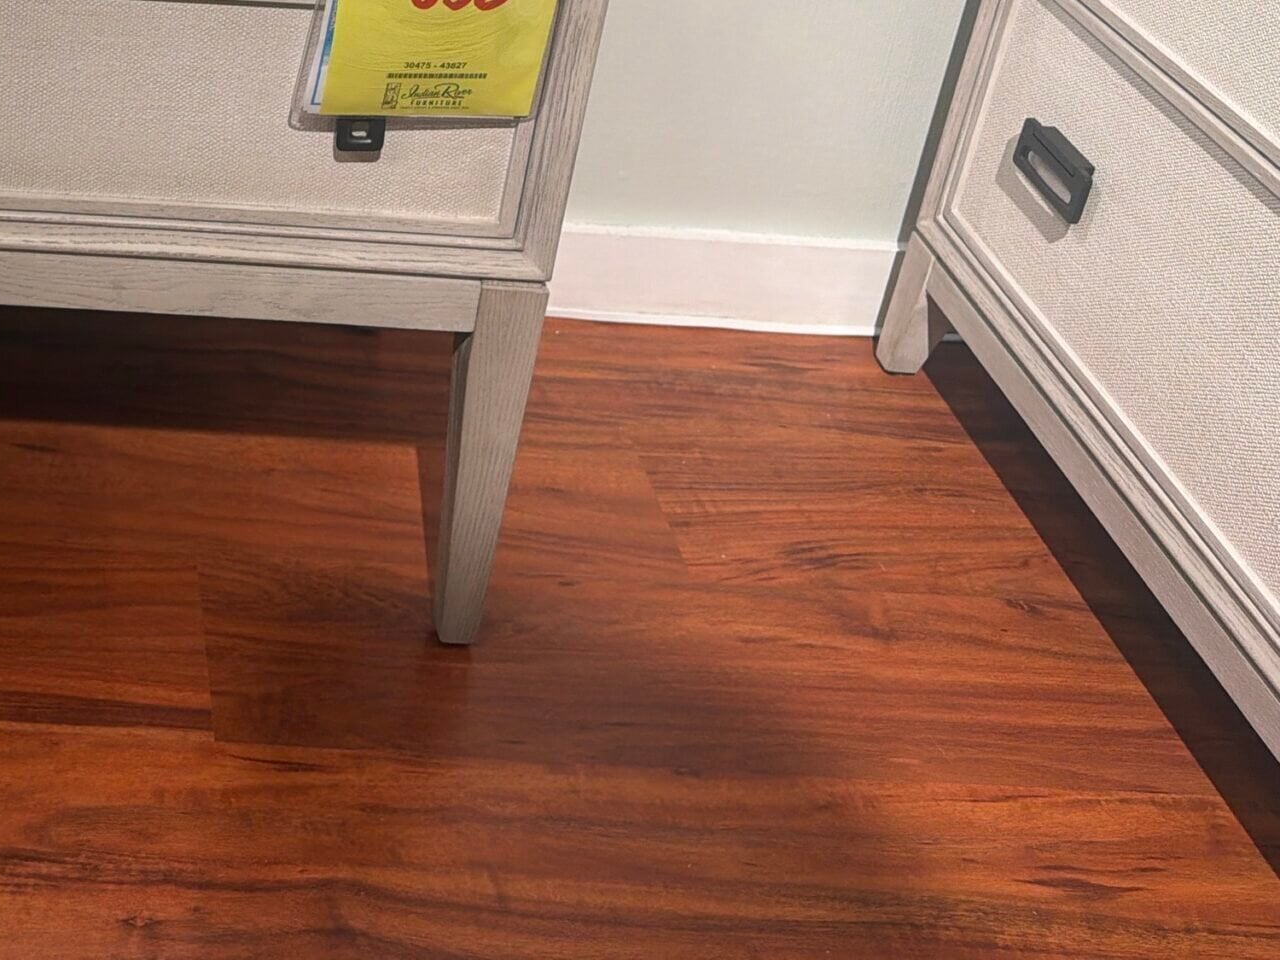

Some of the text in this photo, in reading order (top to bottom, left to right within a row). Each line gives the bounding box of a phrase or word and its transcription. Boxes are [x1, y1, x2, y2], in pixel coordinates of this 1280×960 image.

[403, 61, 432, 70] 30475
[401, 82, 473, 100] Indian River
[410, 99, 463, 107] FURNITURE
